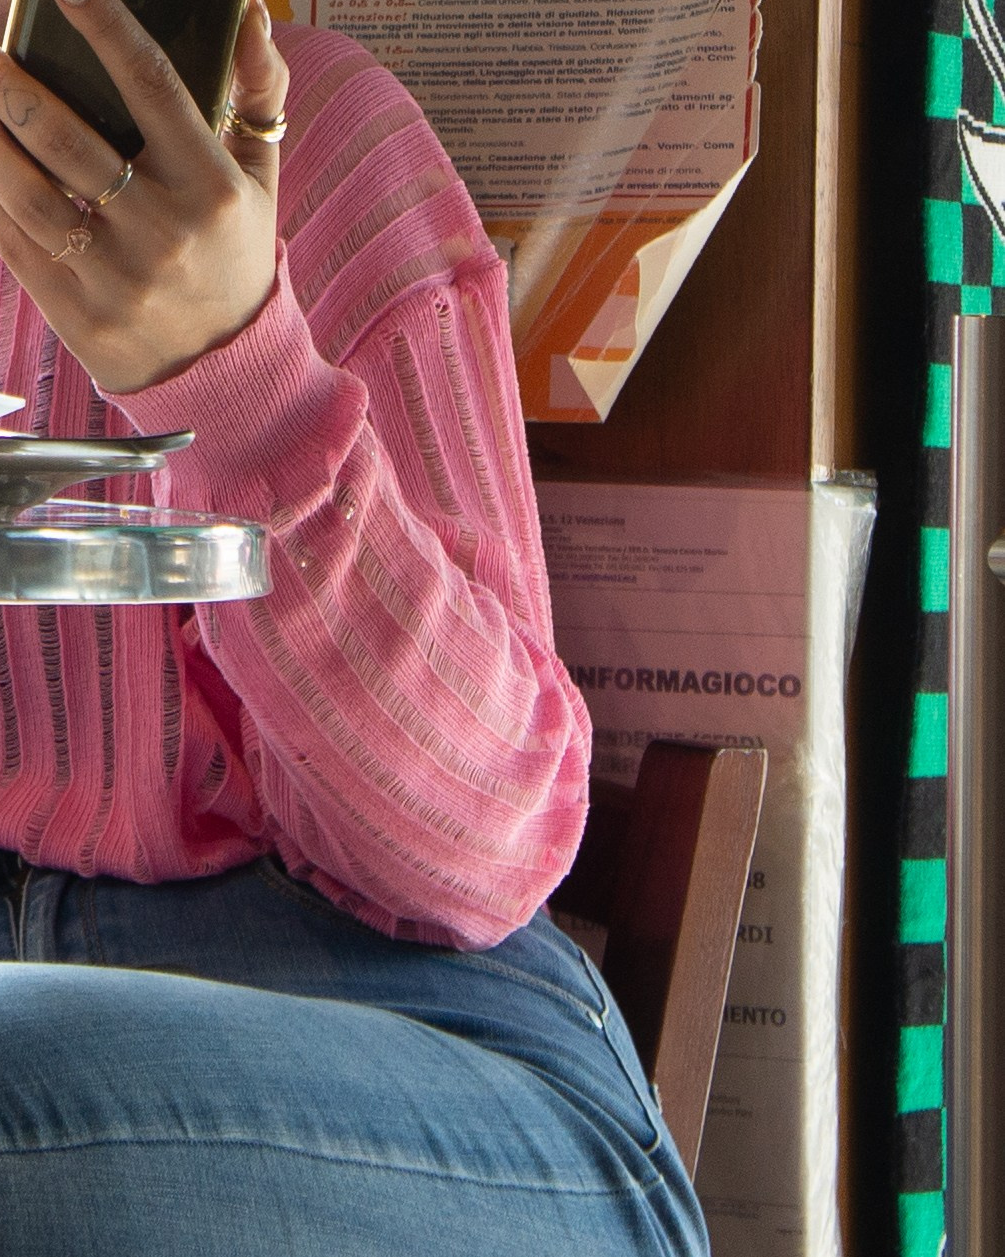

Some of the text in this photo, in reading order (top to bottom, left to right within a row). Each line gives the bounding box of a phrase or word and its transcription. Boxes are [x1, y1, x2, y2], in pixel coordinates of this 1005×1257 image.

[412, 13, 465, 21] Riduzione
[469, 12, 493, 20] della
[497, 11, 541, 21] capacità
[436, 21, 494, 30] movimento
[569, 665, 801, 697] INFORMAGIOCO
